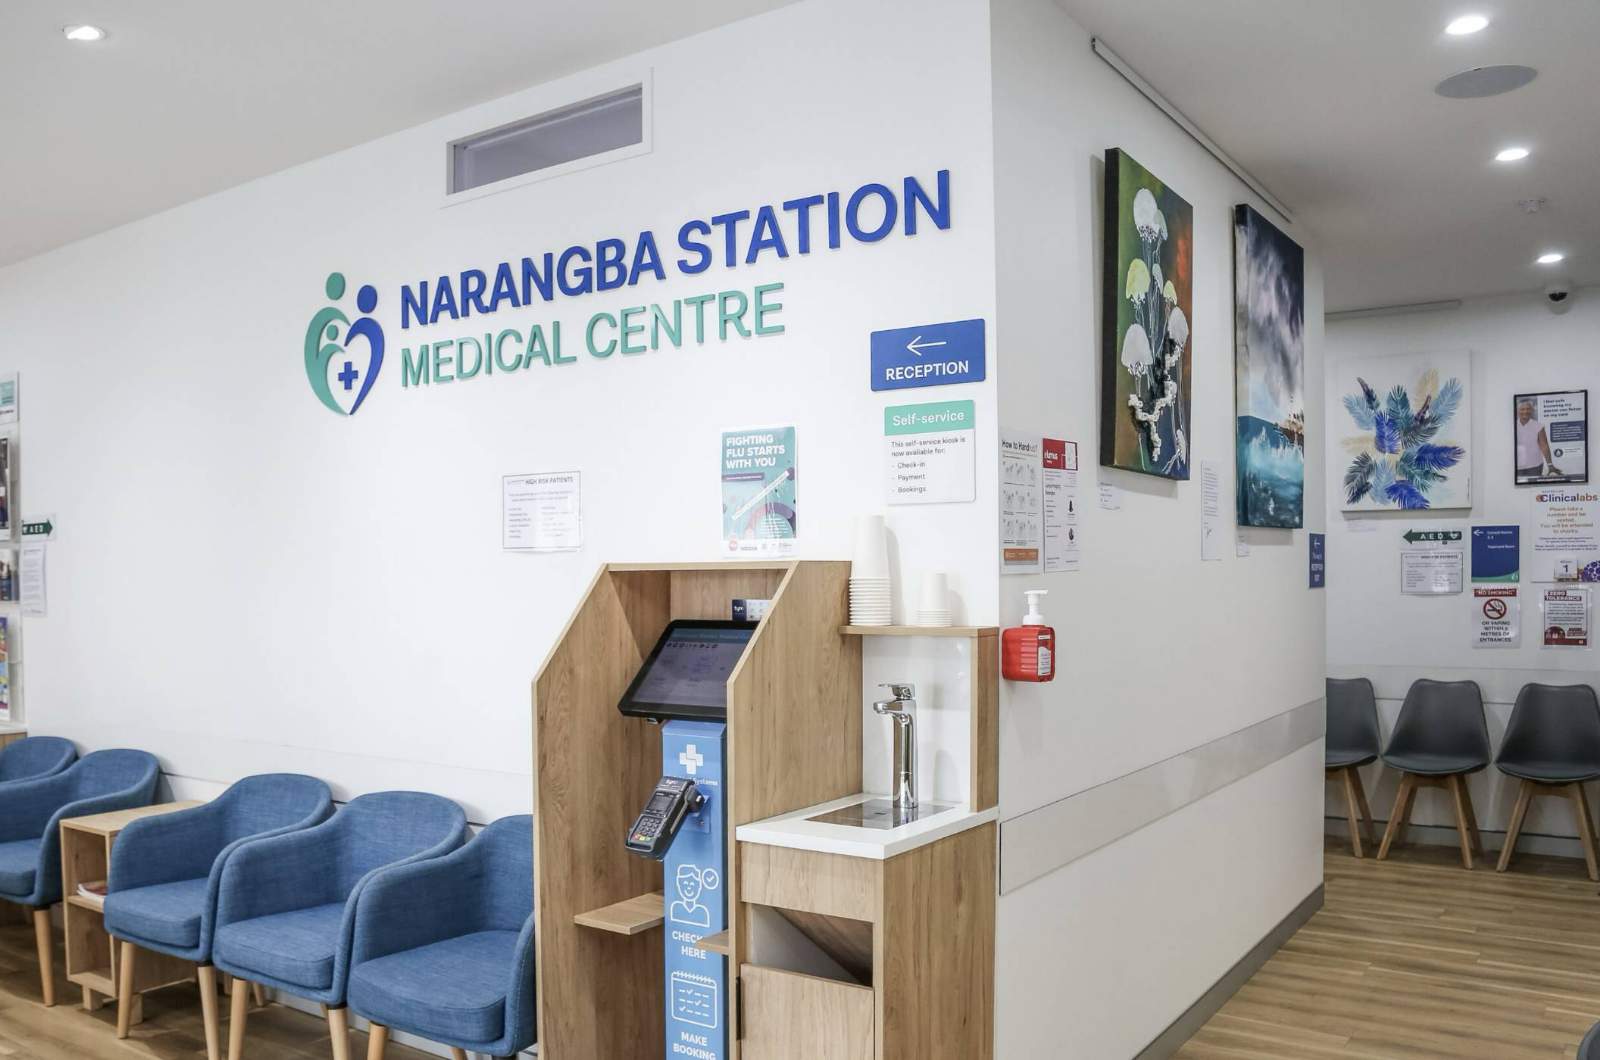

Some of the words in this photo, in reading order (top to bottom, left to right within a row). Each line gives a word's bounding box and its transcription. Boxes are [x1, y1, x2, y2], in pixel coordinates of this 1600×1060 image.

[400, 230, 664, 329] NARANGBA
[677, 169, 951, 276] STATION
[400, 320, 577, 388] MEDICAL
[585, 282, 786, 358] CENTRE
[885, 360, 969, 381] RECEPTION
[892, 409, 965, 426] Self-service
[726, 434, 774, 447] FIGHTING
[905, 438, 941, 447] self-service
[1002, 439, 1013, 448] How
[1013, 441, 1018, 449] to
[726, 447, 745, 458] FLU
[747, 445, 785, 457] STARTS
[905, 448, 934, 456] available
[726, 459, 752, 469] WITH
[754, 457, 776, 467] YOU
[897, 474, 926, 482] Payment
[897, 486, 927, 494] Bookings
[681, 945, 707, 960] HERE
[681, 1031, 708, 1047] MAKE
[672, 1043, 716, 1060] BOOKING
